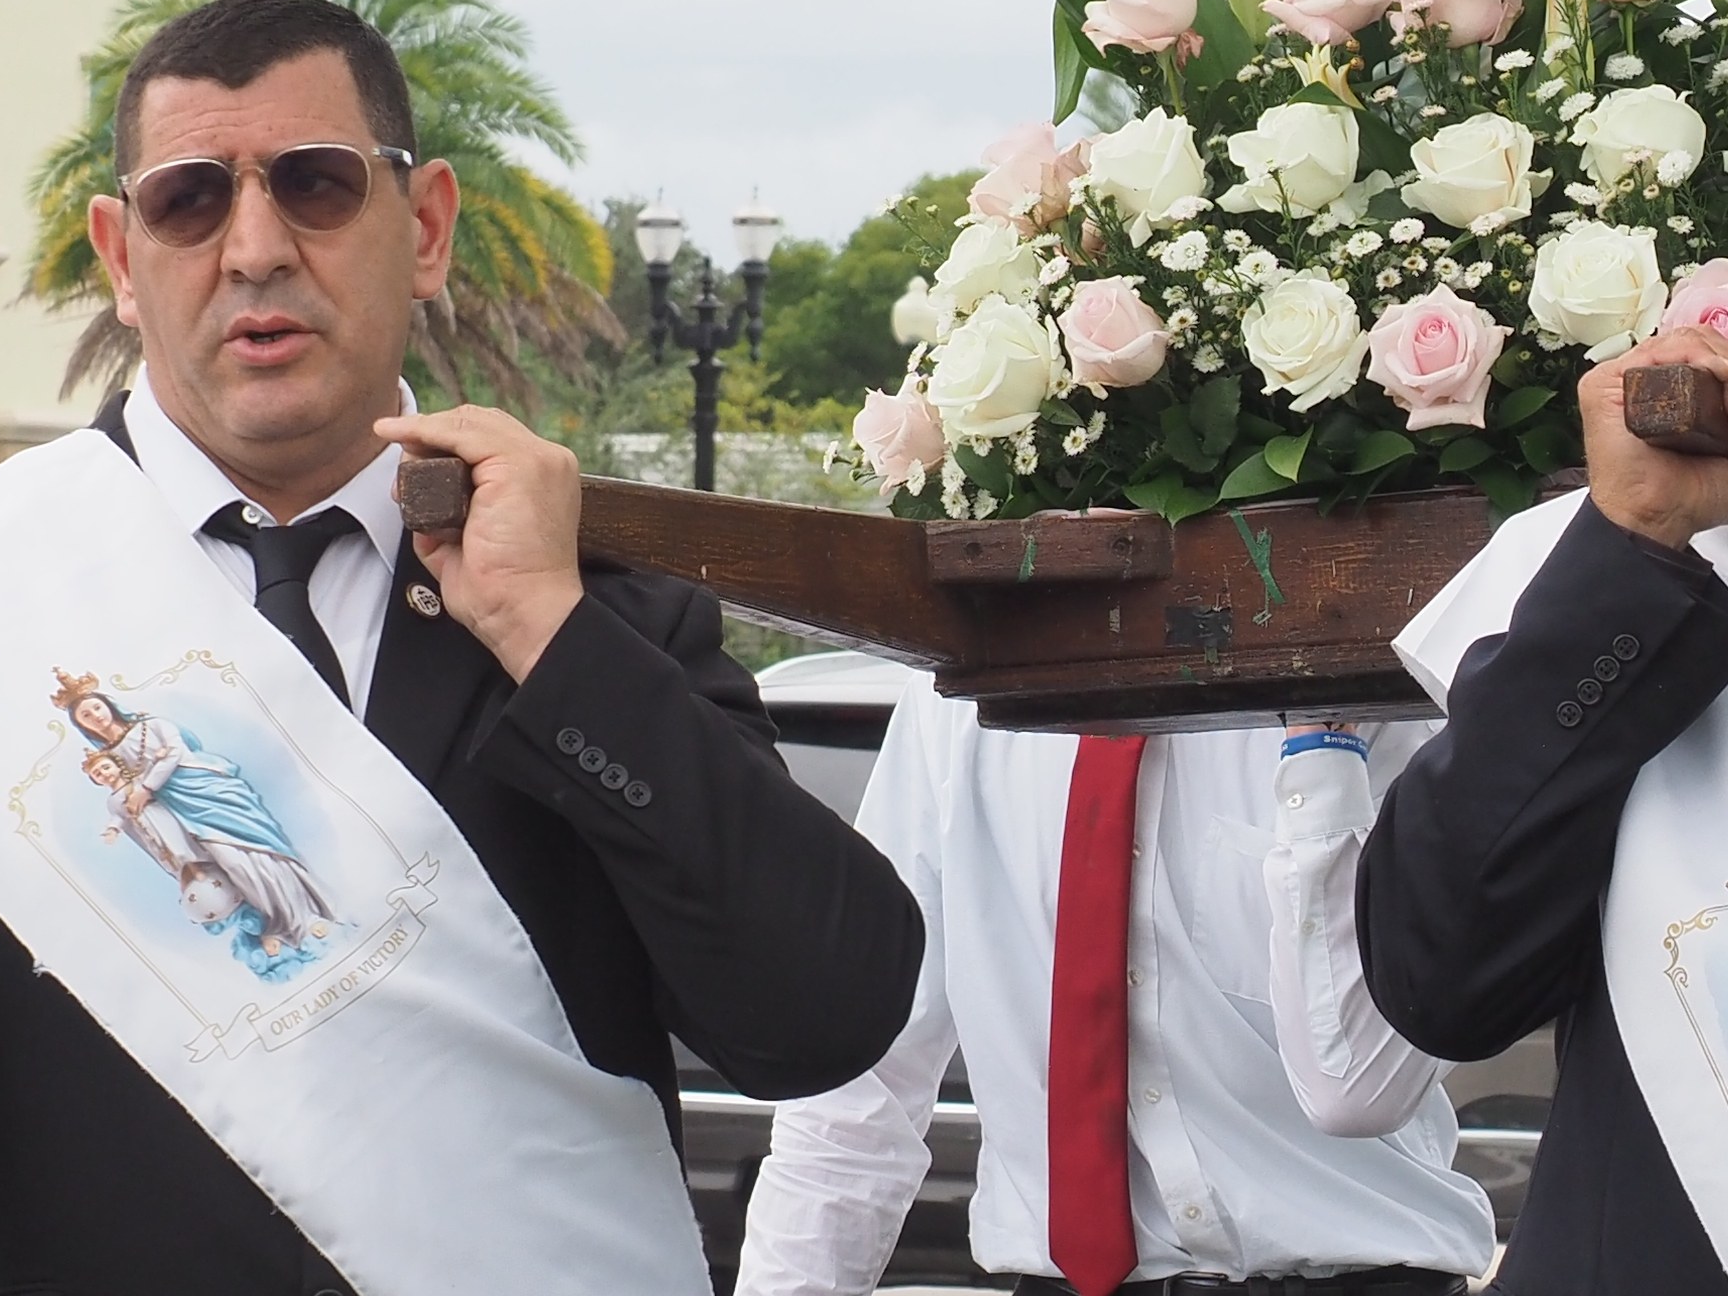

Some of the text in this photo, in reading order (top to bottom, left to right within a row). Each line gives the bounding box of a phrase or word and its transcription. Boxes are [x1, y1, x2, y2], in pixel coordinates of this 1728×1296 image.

[270, 924, 408, 1036] OUR LADY OF VICTORY
